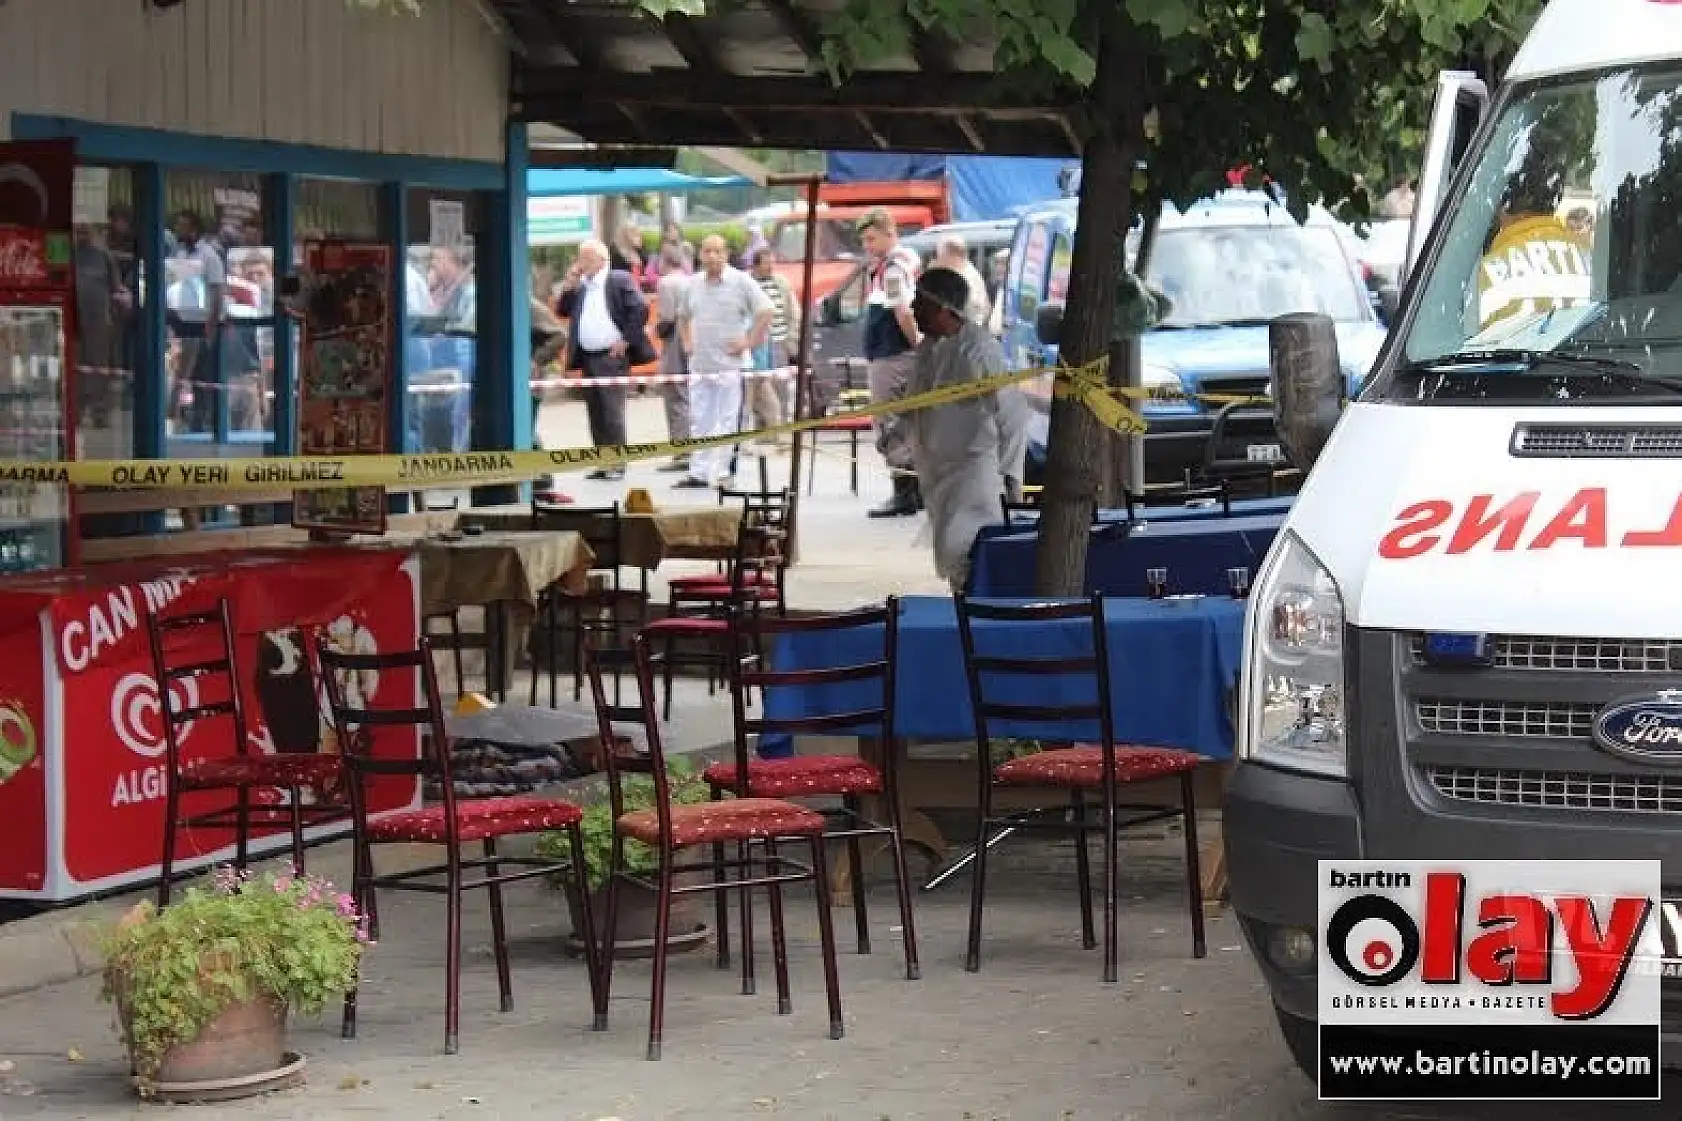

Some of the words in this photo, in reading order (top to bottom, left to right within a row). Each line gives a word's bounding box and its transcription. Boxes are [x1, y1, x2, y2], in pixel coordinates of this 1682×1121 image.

[112, 465, 170, 484] OLAY
[399, 453, 513, 478] JANDARMA
[61, 583, 138, 671] CAN
[1623, 711, 1682, 744] For
